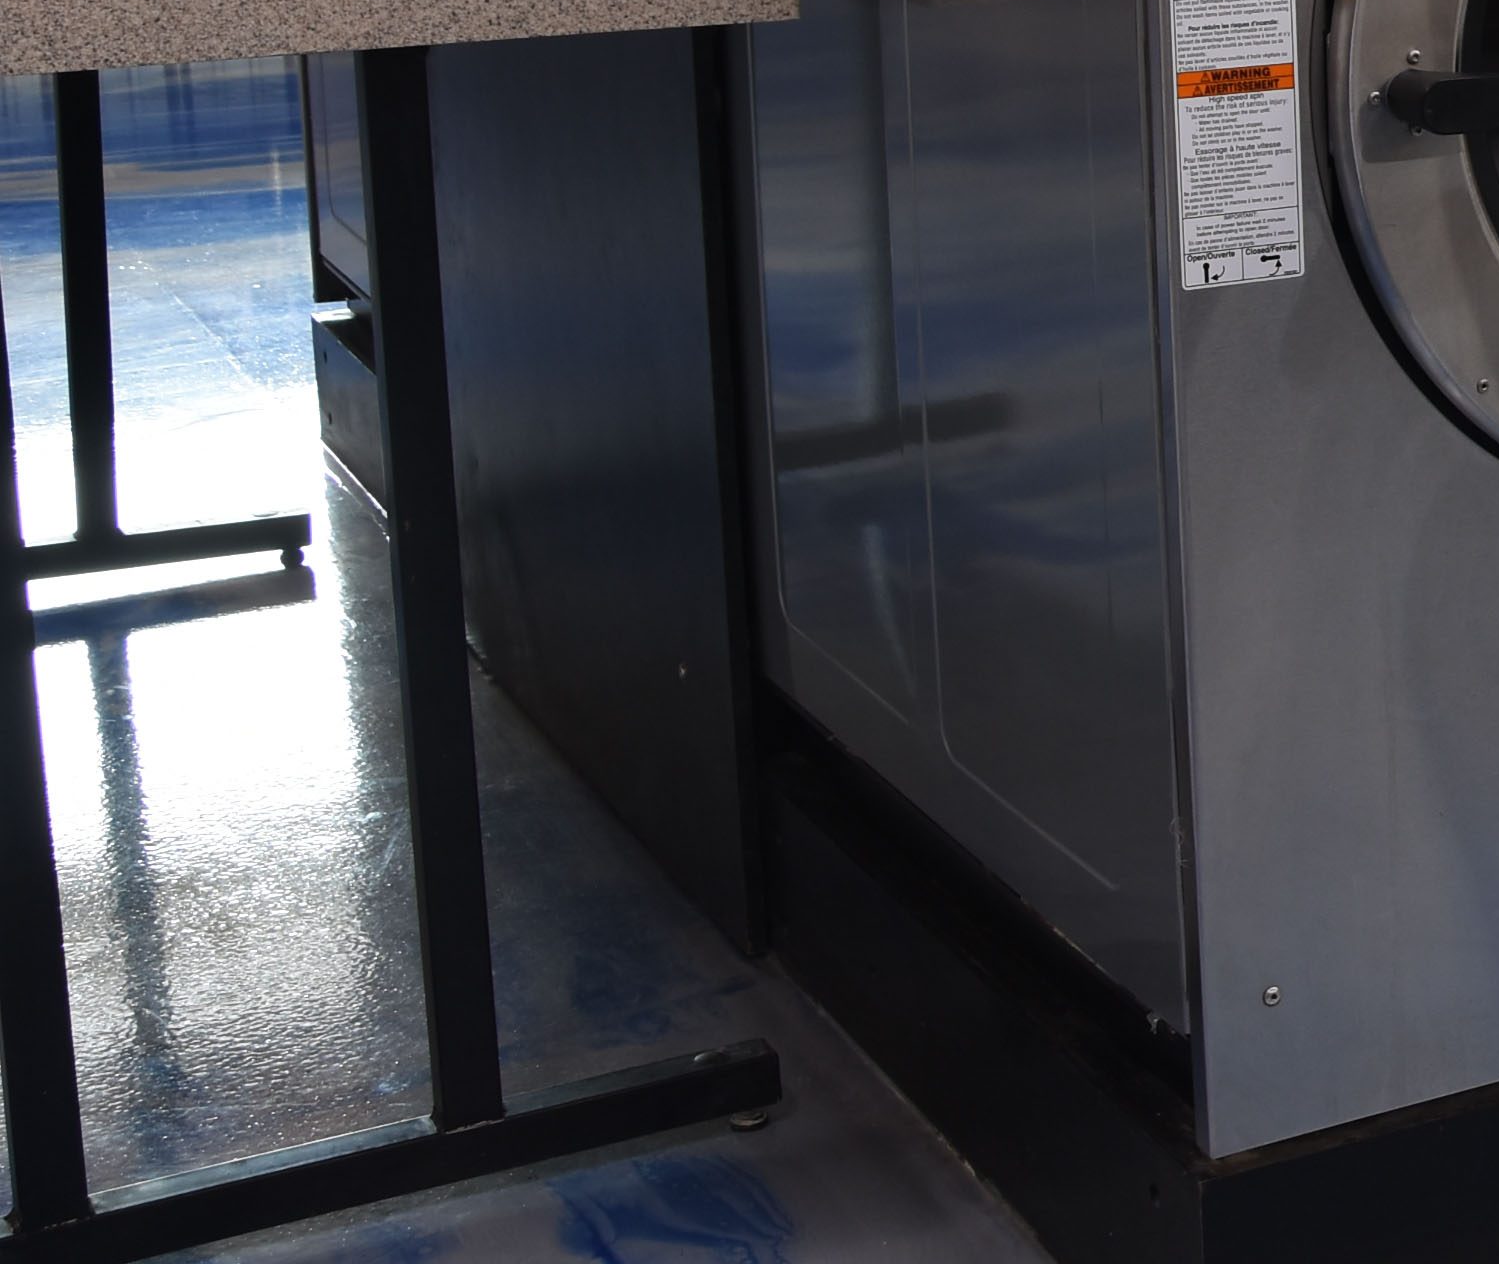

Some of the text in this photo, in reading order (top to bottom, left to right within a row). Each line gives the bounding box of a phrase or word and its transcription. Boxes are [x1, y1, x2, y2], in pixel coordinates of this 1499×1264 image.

[1211, 67, 1270, 80] WARNING
[1204, 79, 1279, 94] AVERTISSEMENT
[1227, 94, 1248, 102] speed
[1195, 147, 1227, 155] Essorage
[1245, 244, 1297, 255] Closed/Fermée
[1187, 251, 1235, 263] Open/Ouverte
